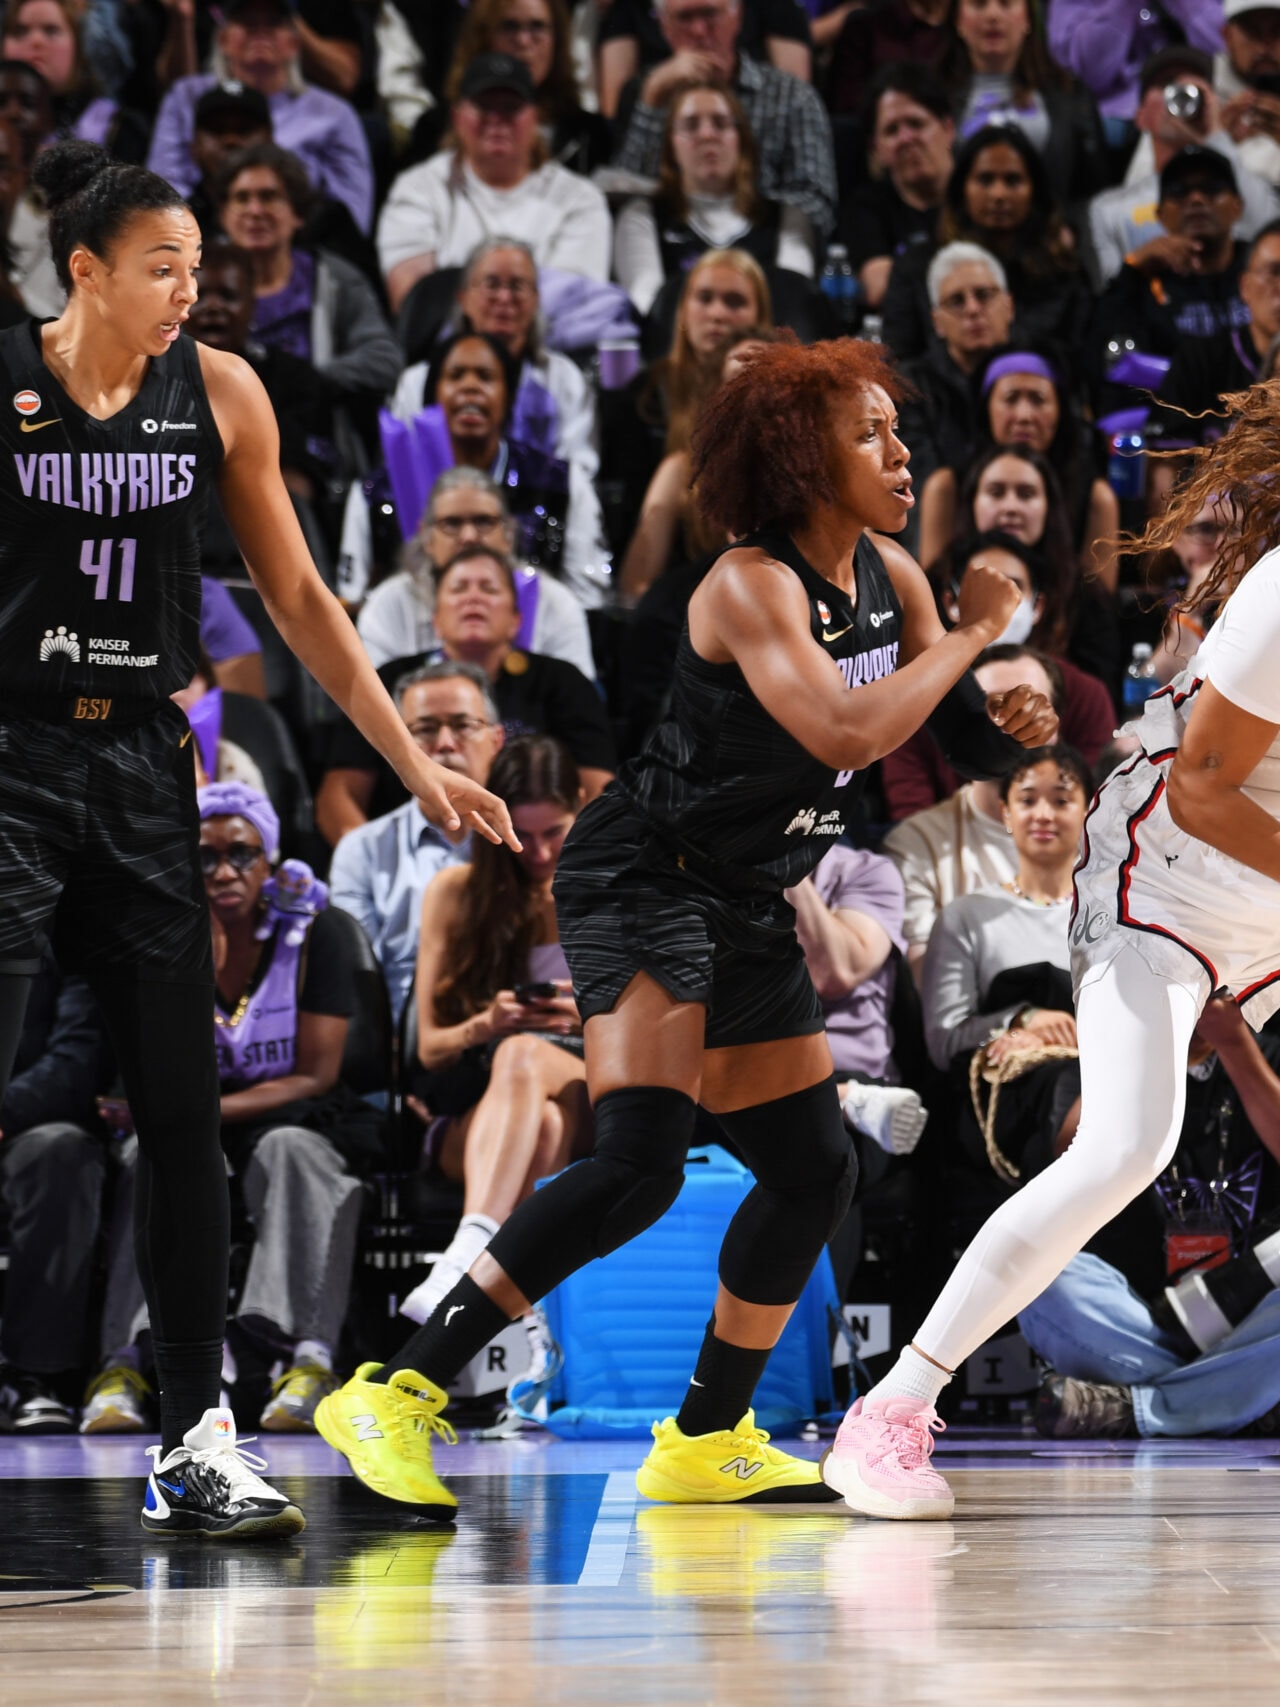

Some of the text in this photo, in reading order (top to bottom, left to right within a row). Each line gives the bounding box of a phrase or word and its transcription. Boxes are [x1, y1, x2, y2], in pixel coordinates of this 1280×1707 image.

[161, 420, 197, 432] freedom
[13, 453, 197, 518] VALKYRIES
[79, 537, 138, 602] 41
[88, 638, 130, 651] KAISER
[87, 652, 160, 668] PERMANENTE
[487, 1346, 506, 1372] R
[350, 1414, 385, 1443] N
[719, 1456, 764, 1480] N
